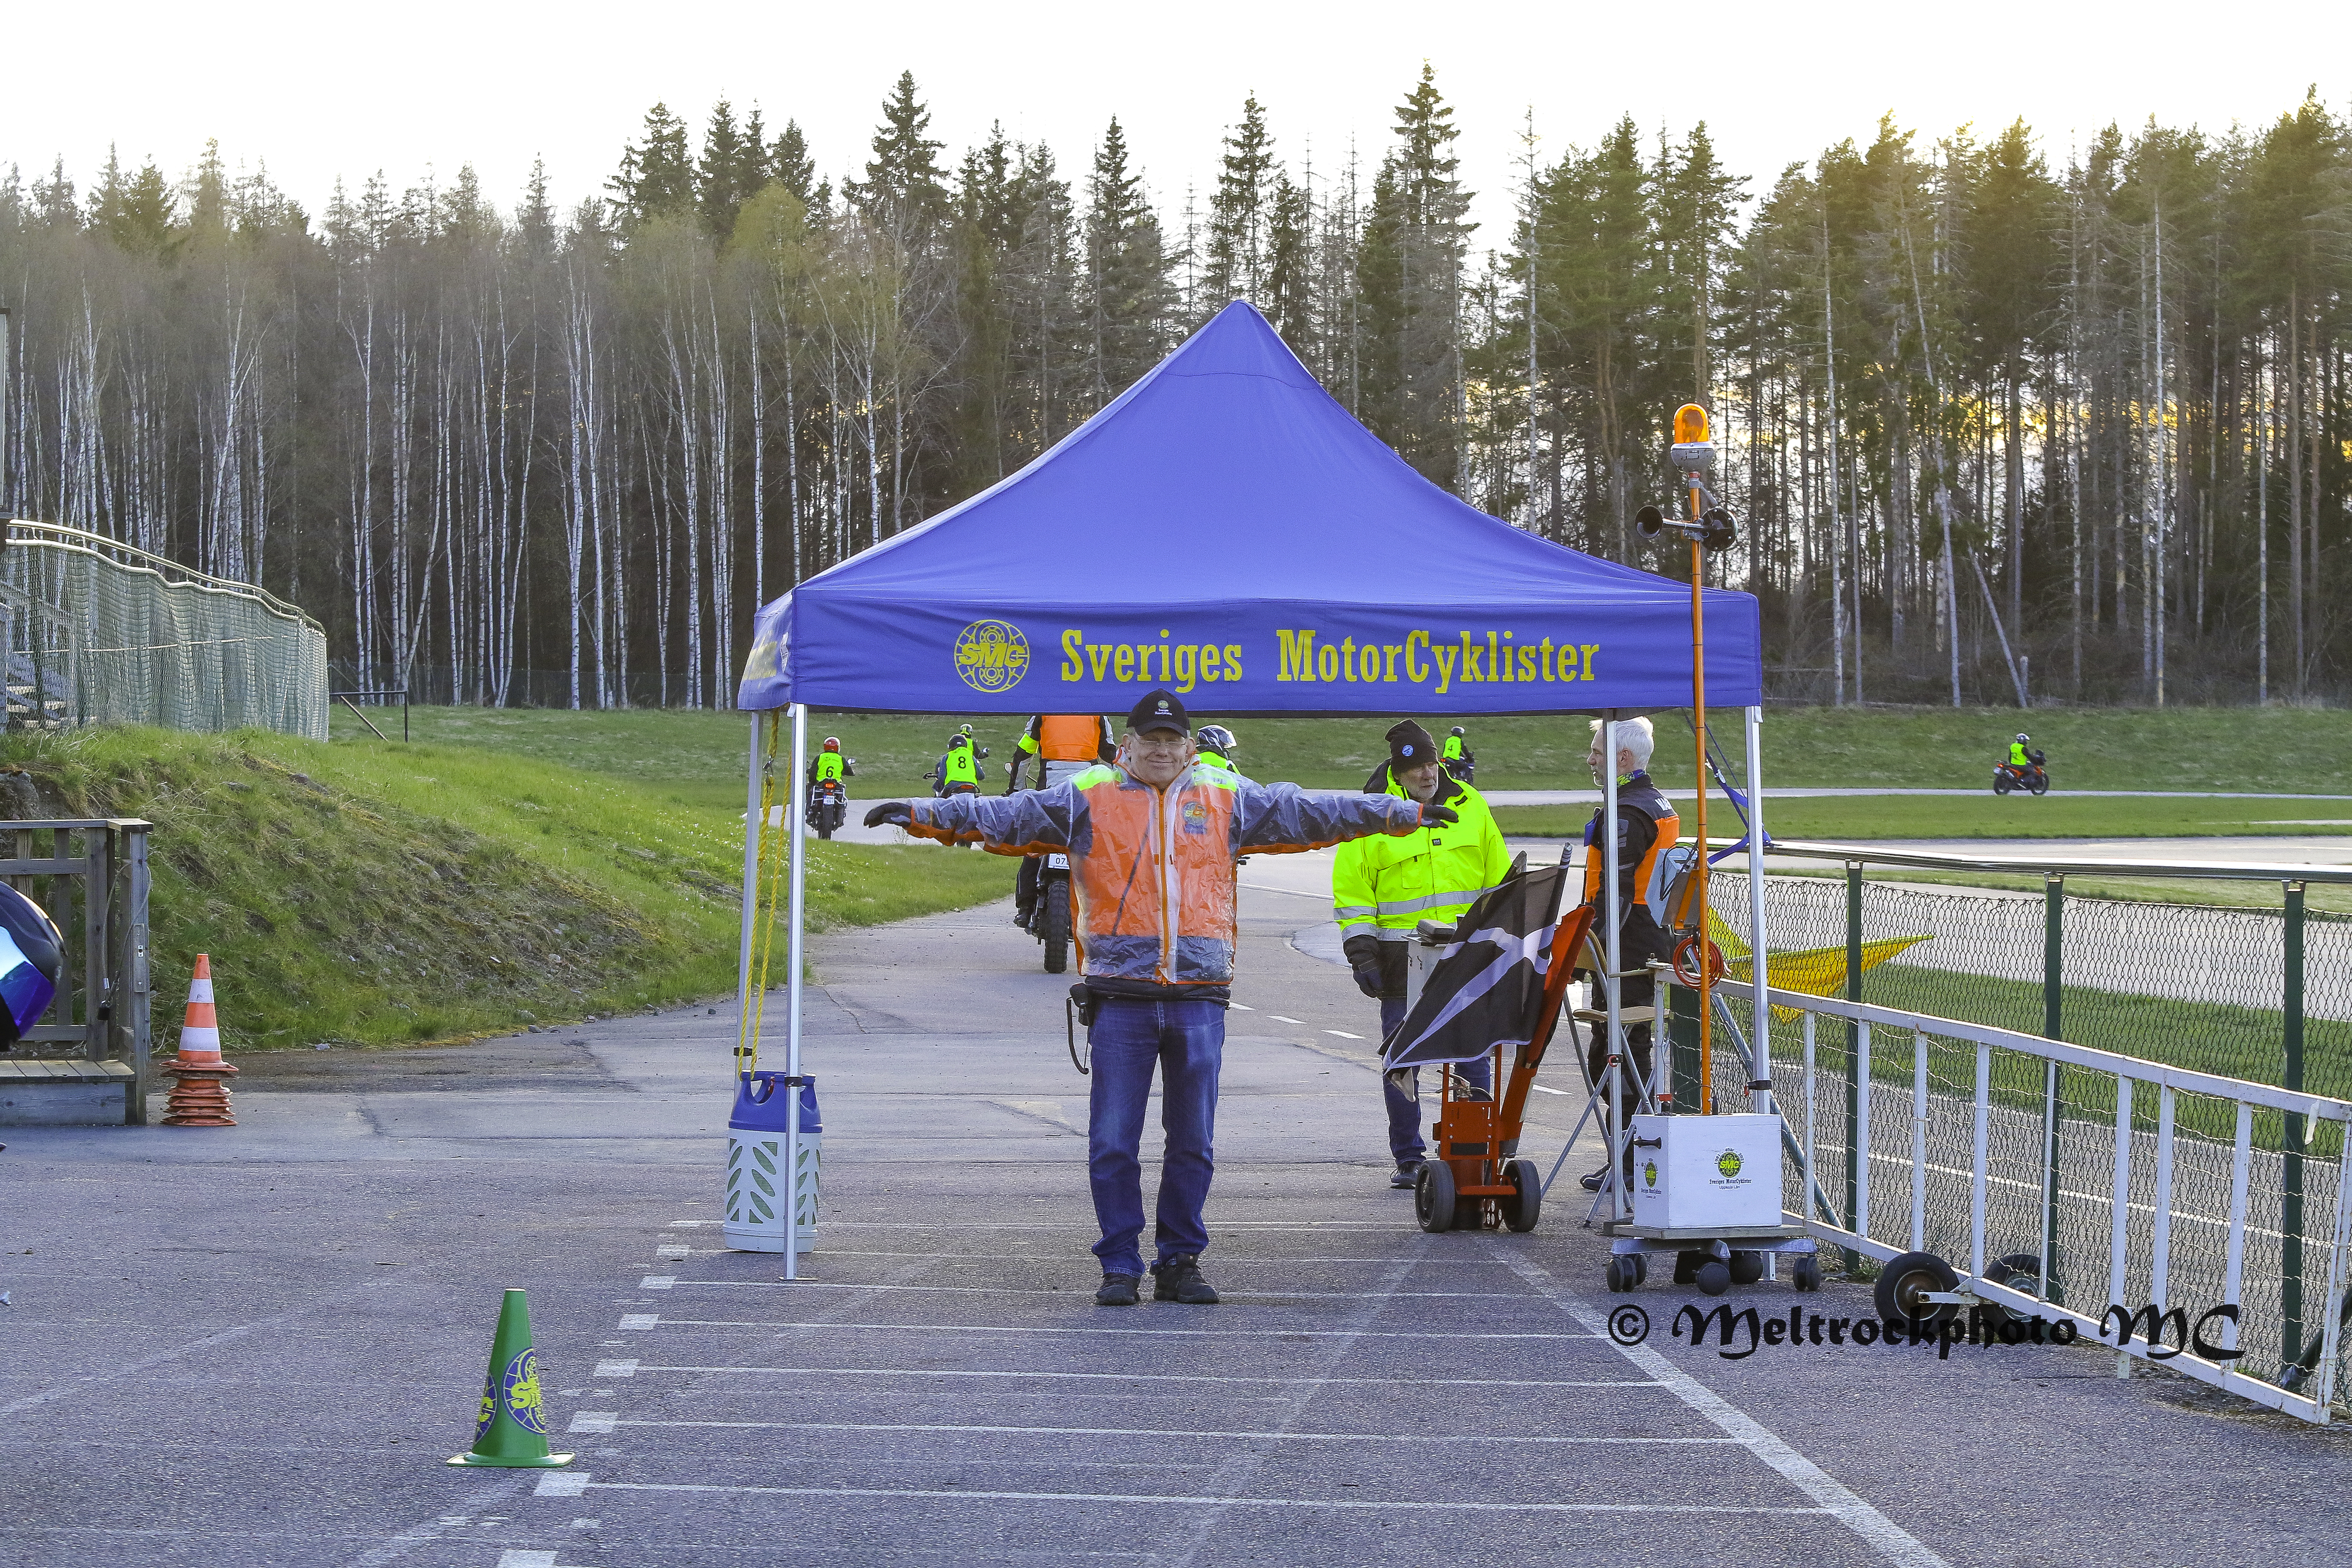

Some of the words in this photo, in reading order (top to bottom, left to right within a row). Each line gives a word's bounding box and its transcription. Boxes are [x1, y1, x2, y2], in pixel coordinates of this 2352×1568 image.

[958, 642, 1026, 669] SMC
[1062, 629, 1243, 693] Sveriges
[1277, 629, 1599, 693] MotorCyklister
[958, 756, 966, 769] 8
[826, 766, 834, 778] 6
[1720, 1161, 1740, 1169] SMC
